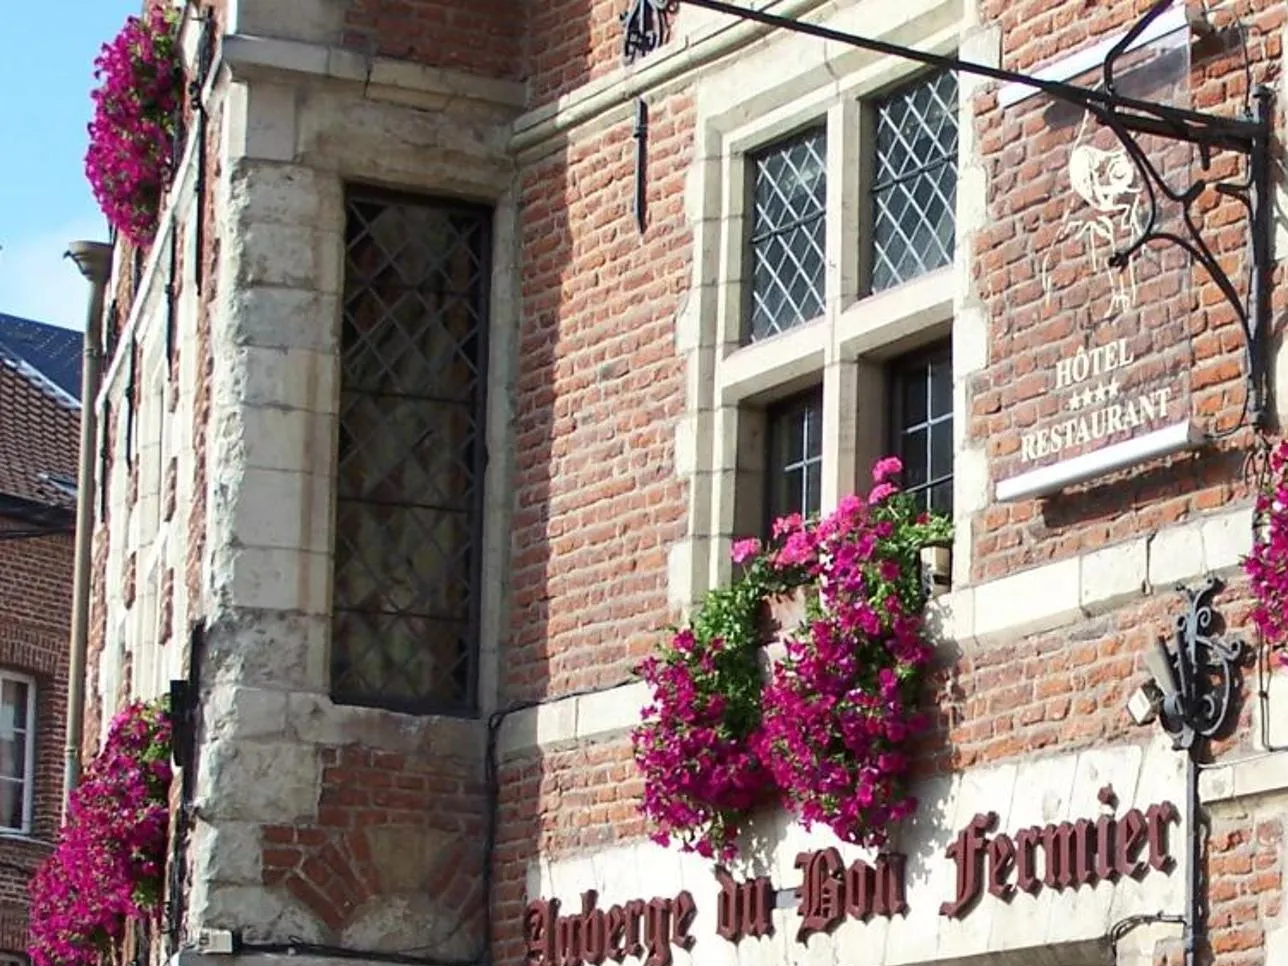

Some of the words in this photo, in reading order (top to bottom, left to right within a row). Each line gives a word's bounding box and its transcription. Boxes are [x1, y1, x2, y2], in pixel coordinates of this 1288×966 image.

[1055, 338, 1135, 389] HÔTEL
[1020, 388, 1172, 463] RESTAURANT
[711, 863, 777, 945] du
[795, 846, 912, 947] Bon
